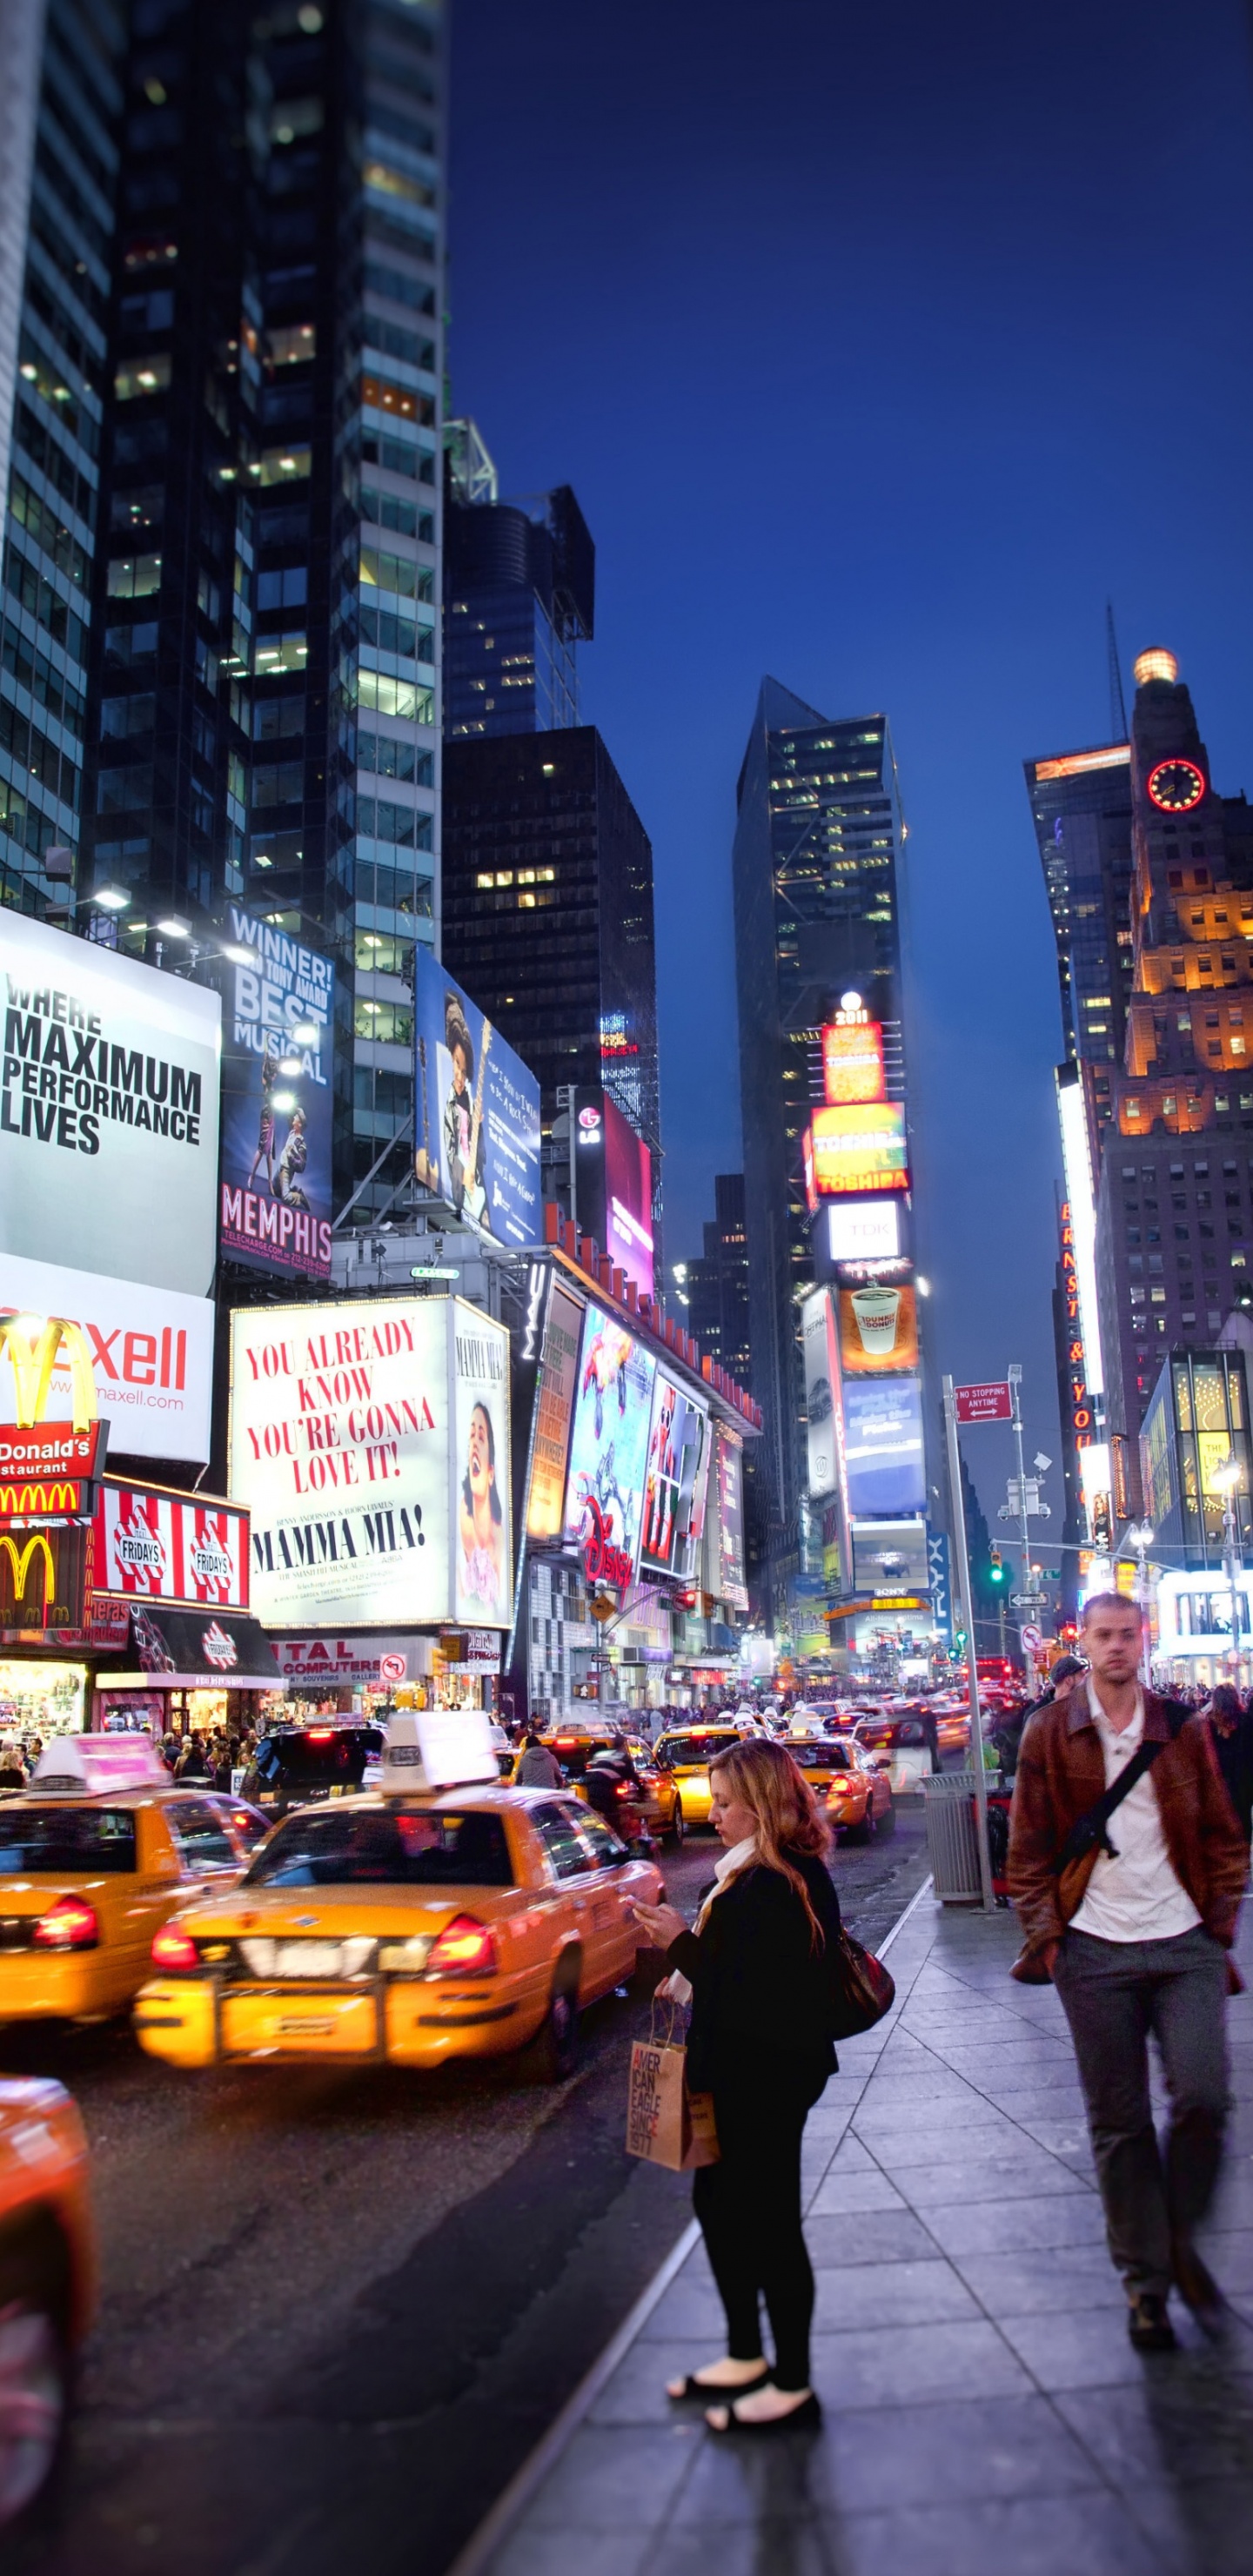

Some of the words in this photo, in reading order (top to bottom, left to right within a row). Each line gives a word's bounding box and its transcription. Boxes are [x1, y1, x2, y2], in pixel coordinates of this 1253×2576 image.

[231, 908, 332, 991] WINNER!
[5, 972, 102, 1036] WHERE
[266, 960, 293, 991] TONY
[295, 976, 328, 1010] AWARD
[235, 966, 327, 1055] BEST
[835, 1010, 868, 1025] 2011
[3, 1007, 202, 1116] MAXIMUM
[0, 1090, 100, 1156] LIVES
[2, 1055, 200, 1146] PERFORMANCE
[814, 1130, 907, 1152] TOSHIBA
[818, 1170, 908, 1193] TOSHIBA
[222, 1183, 332, 1263] MEMPHIS
[850, 1224, 891, 1237] TDK
[1061, 1203, 1079, 1318] ERNST
[245, 1340, 296, 1381] YOU
[305, 1317, 415, 1372] ALREADY
[1069, 1341, 1084, 1359] &
[298, 1365, 374, 1412] KNOW
[968, 1398, 998, 1408] ANYTIME
[972, 1387, 1005, 1398] STOPPING
[247, 1412, 341, 1460] YOU'RE
[348, 1396, 436, 1444] GONNA
[1206, 1444, 1223, 1452] THE
[292, 1450, 359, 1494] LOVE
[365, 1441, 400, 1482] IT!
[252, 1518, 358, 1573] MAMMA
[363, 1504, 425, 1555] MIA!
[283, 1660, 380, 1674] COMPUTERS
[633, 2048, 661, 2075] AMER
[633, 2068, 656, 2094] ICAN
[630, 2110, 659, 2137] SINCE
[631, 2089, 661, 2117] EAGLE
